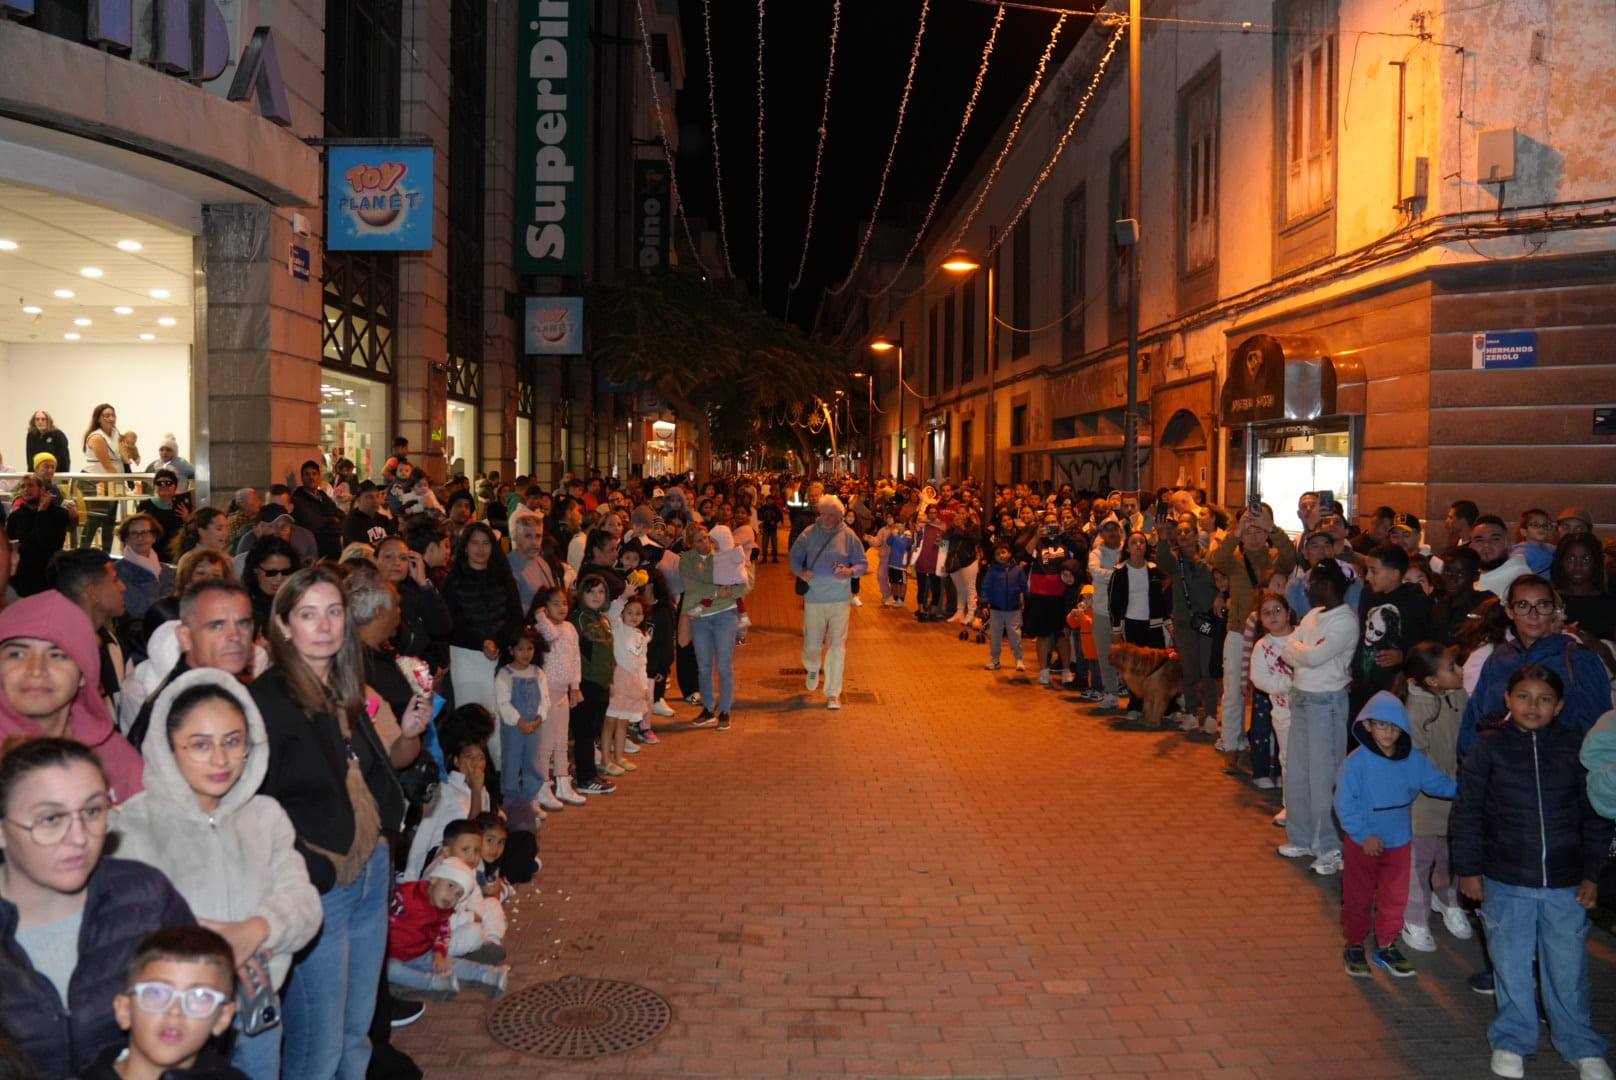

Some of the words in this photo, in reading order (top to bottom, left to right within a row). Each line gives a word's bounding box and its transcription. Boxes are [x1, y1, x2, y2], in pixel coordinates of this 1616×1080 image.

[345, 162, 407, 193] TOY
[339, 191, 422, 210] PLANET
[1486, 346, 1534, 354] HERMANOS
[1486, 353, 1519, 361] ZEROLO
